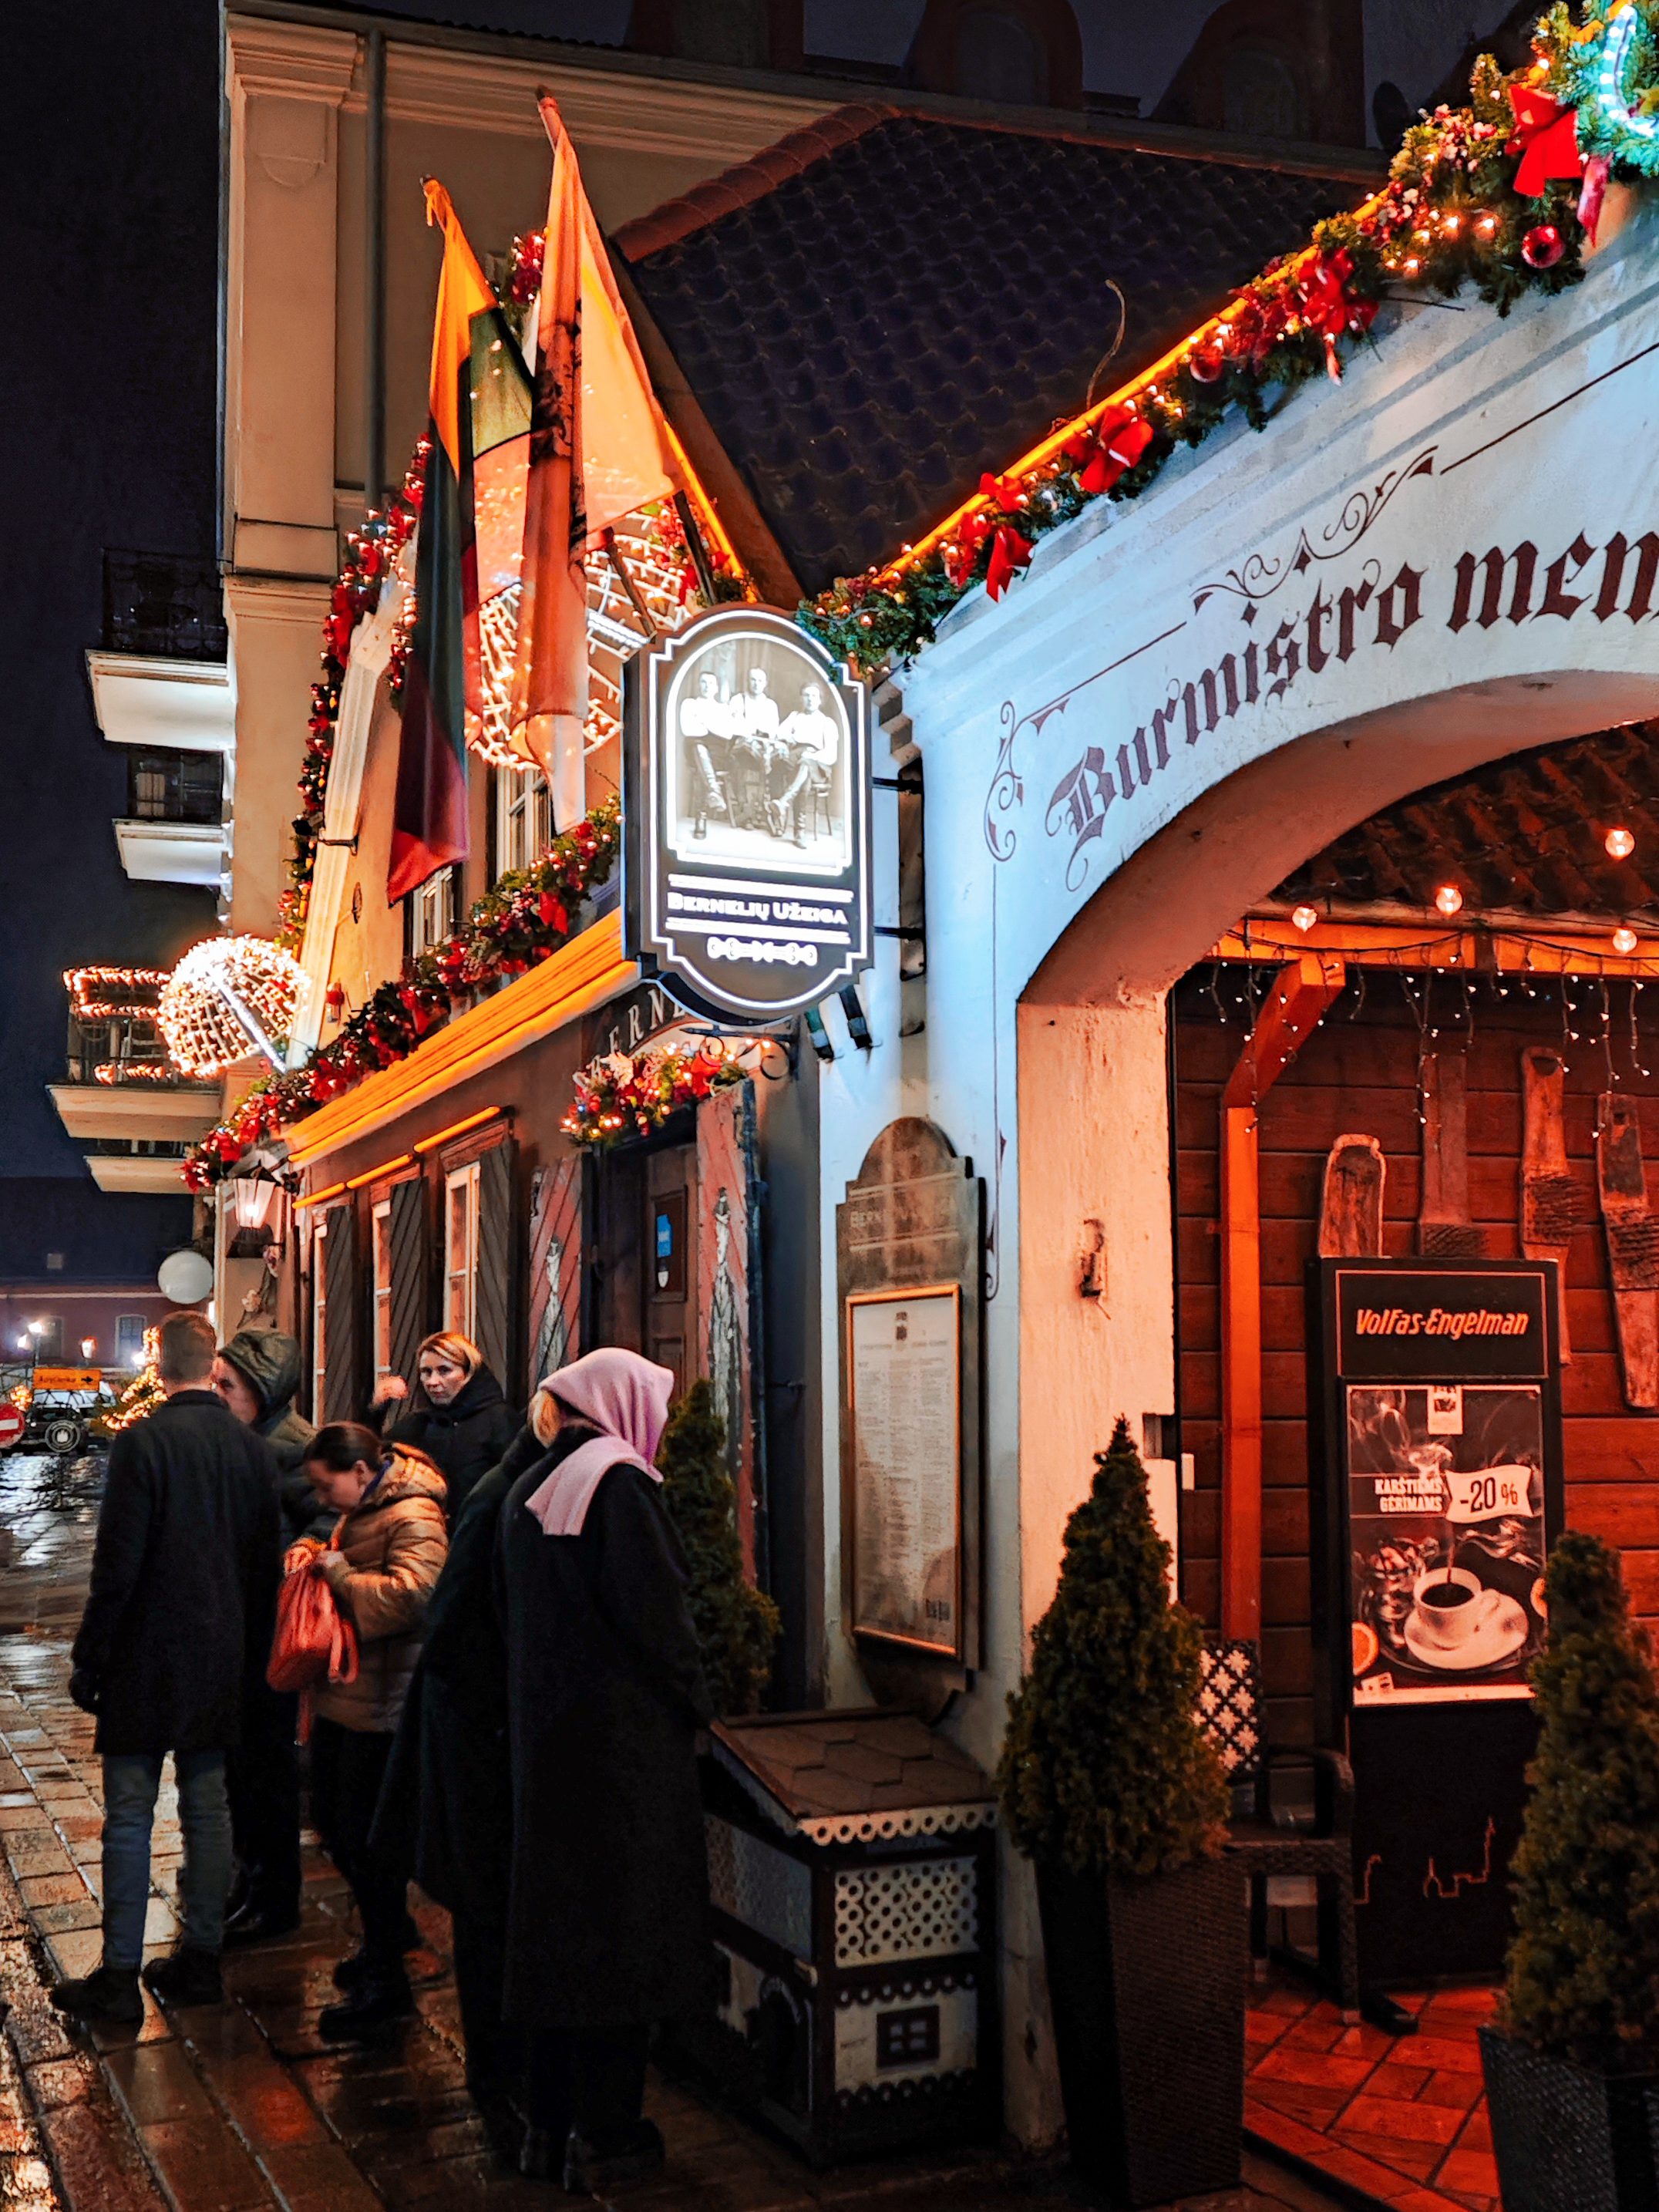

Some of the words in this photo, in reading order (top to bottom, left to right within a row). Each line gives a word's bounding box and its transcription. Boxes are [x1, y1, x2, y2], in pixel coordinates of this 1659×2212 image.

[1045, 559, 1426, 891] Burmistro
[1446, 527, 1659, 635] men
[772, 901, 848, 925] UŽEIGA
